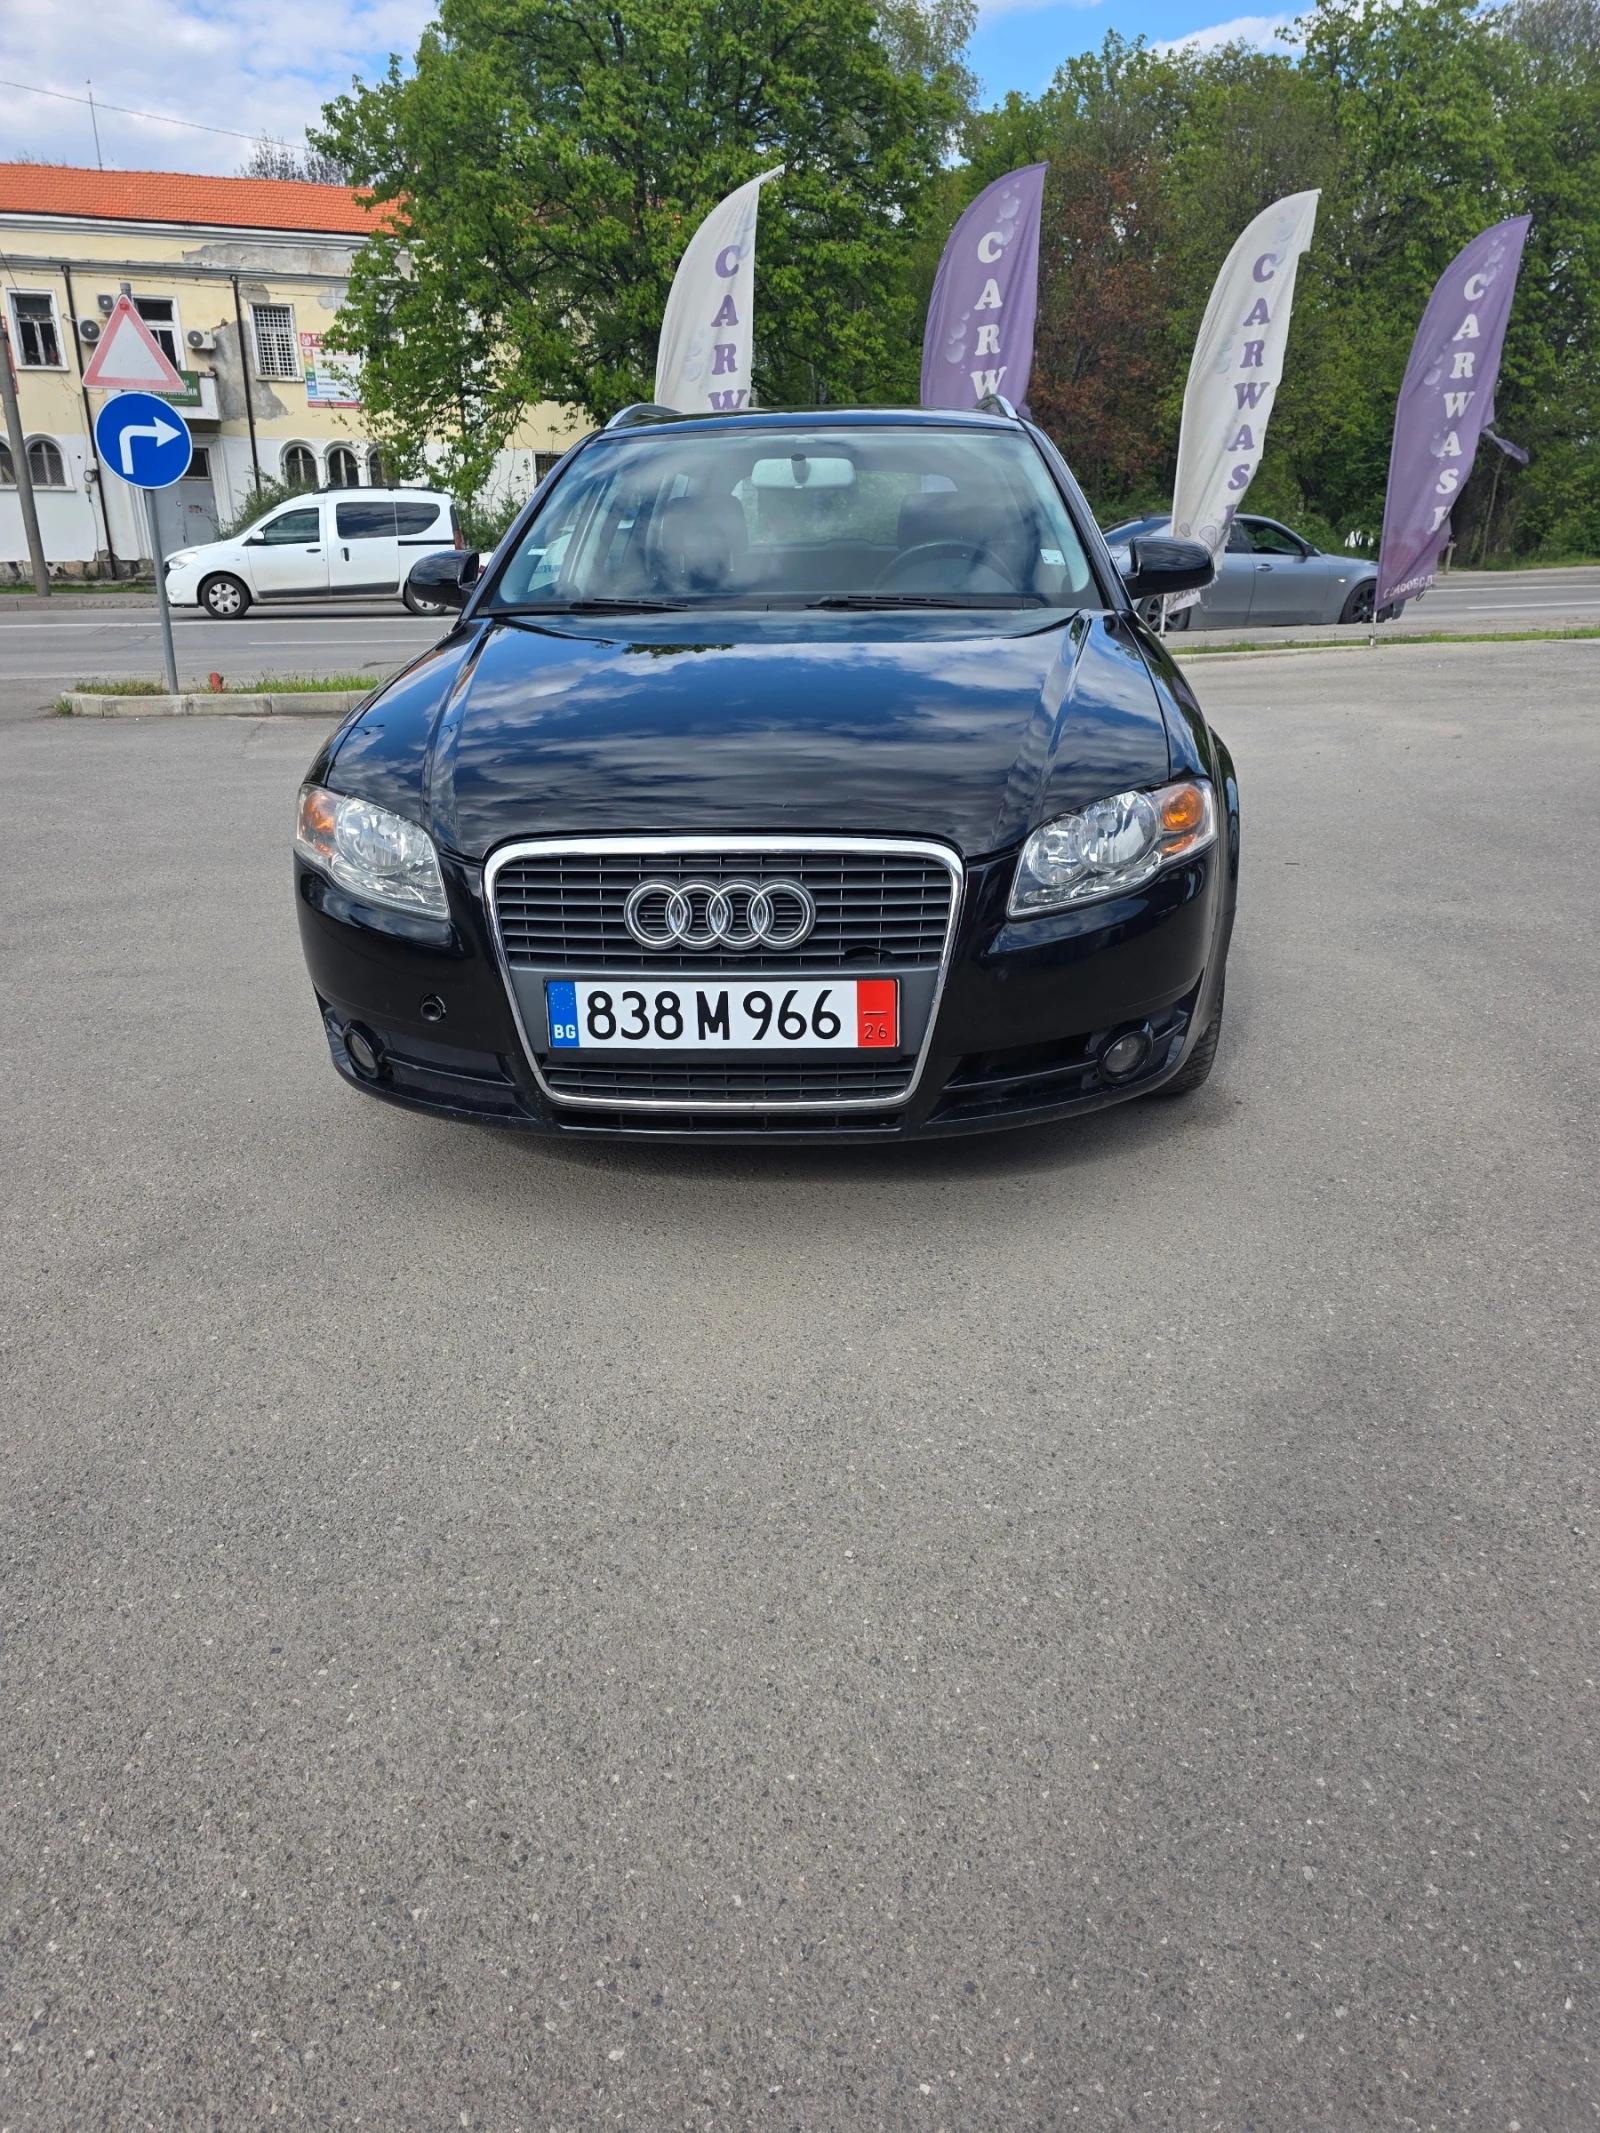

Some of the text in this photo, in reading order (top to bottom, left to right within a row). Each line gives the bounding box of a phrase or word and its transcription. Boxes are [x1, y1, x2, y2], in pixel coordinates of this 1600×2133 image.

[553, 989, 888, 1041] BG 838 M 966 26
